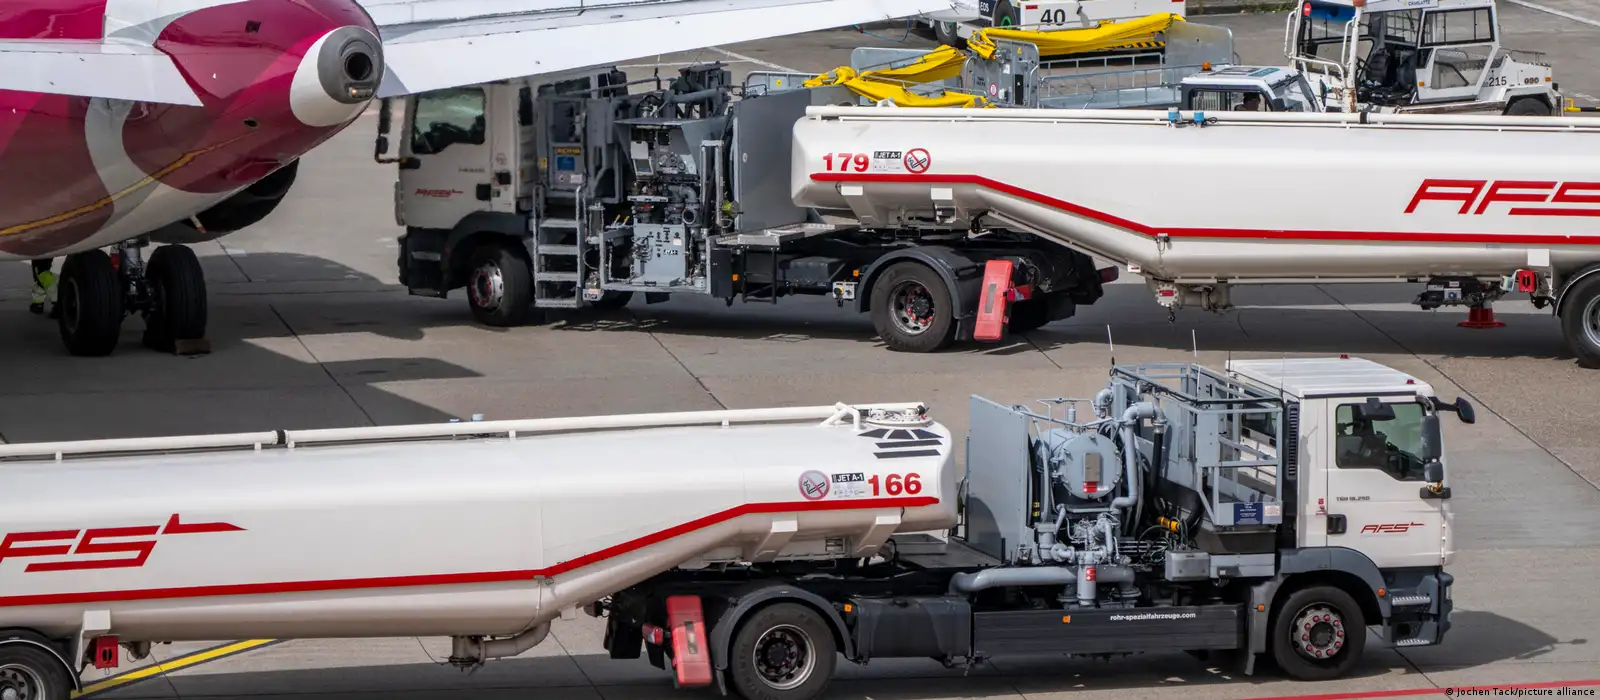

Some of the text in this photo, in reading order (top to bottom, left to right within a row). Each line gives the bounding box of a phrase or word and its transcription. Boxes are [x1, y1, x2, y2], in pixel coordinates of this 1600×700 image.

[980, 2, 990, 12] EOS
[1040, 9, 1066, 26] 40
[1489, 76, 1507, 87] 215
[823, 152, 869, 172] 179
[838, 472, 864, 482] JET A-1
[868, 473, 923, 496] 166
[1360, 523, 1409, 534] AFS
[1110, 612, 1196, 621] rohr-spezialfahrzeuge.com
